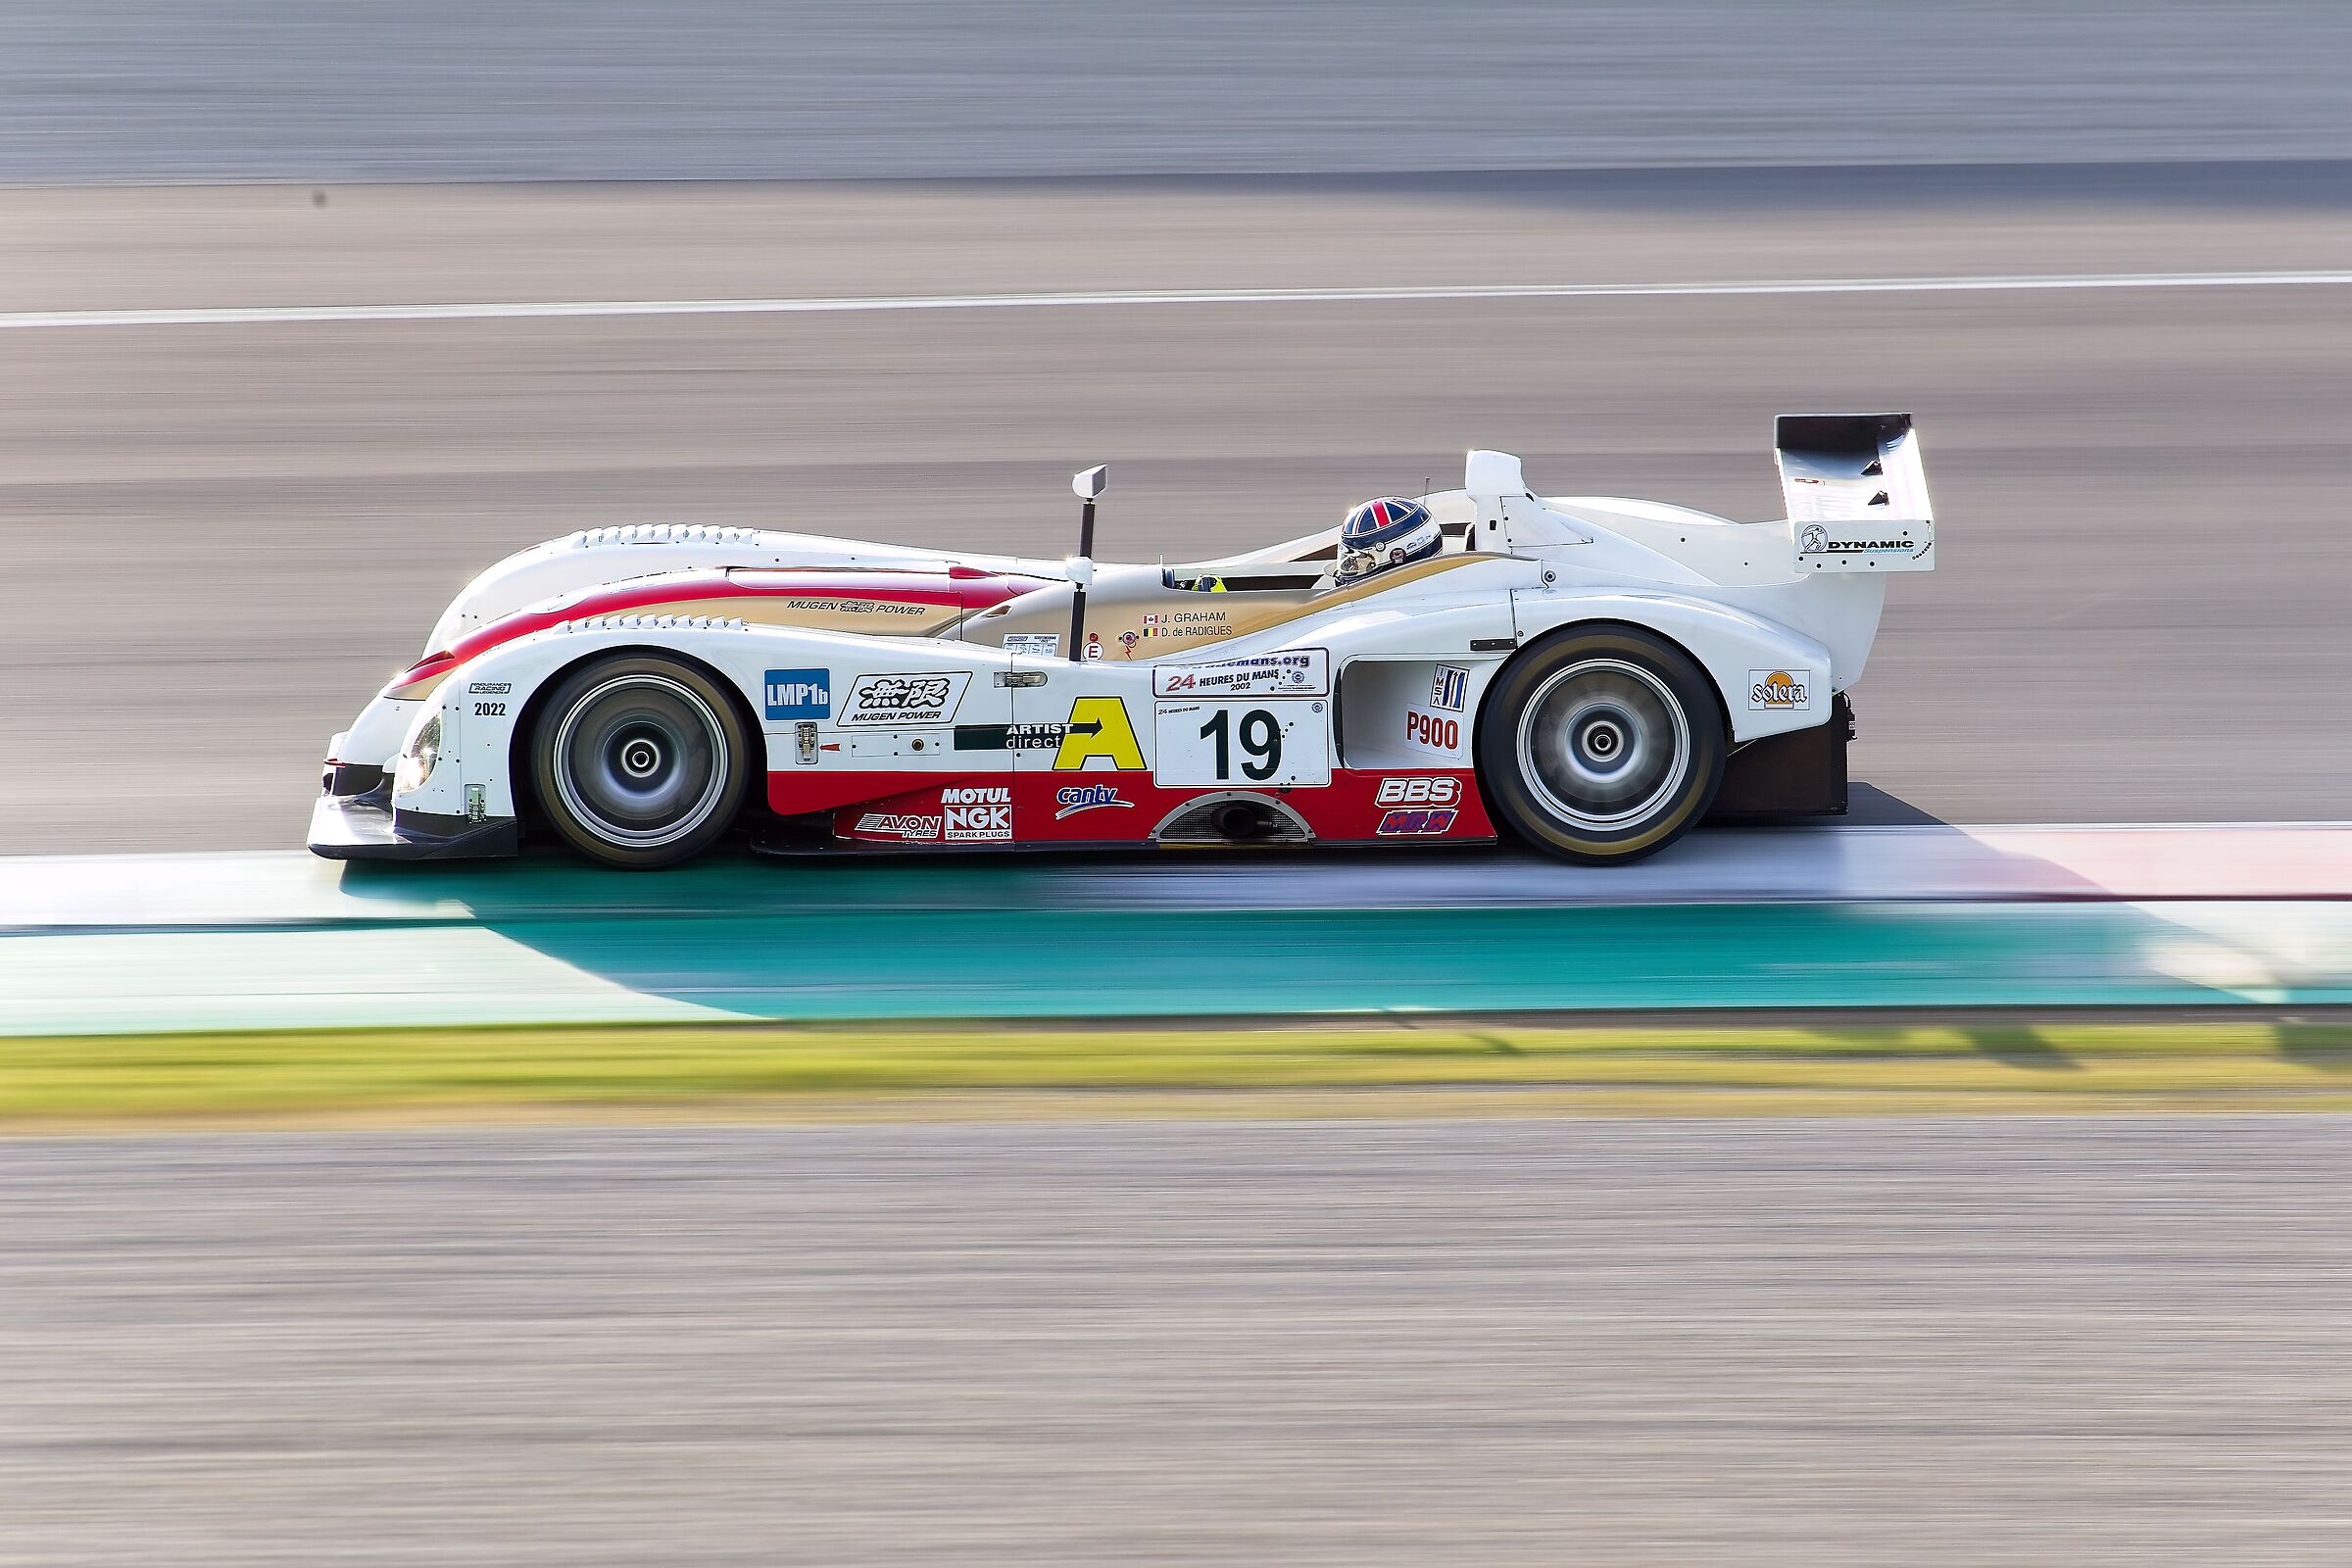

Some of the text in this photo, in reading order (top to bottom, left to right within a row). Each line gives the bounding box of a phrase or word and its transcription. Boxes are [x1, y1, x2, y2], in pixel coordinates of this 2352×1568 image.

[1828, 540, 1915, 549] DYNAMIC
[787, 601, 839, 611] MUGEN
[875, 605, 926, 615] POWER
[1161, 612, 1226, 623] J. GRAHAM
[1161, 625, 1233, 637] D. de RADIGUES
[1088, 645, 1099, 658] E
[1165, 673, 1196, 692] 24
[1199, 674, 1235, 687] HEURES
[1236, 672, 1250, 682] DU
[1251, 668, 1279, 680] MANS
[1230, 681, 1251, 692] 2002
[1432, 667, 1445, 706] IMSA
[766, 683, 829, 707] LMP1b
[1751, 681, 1808, 703] solera
[474, 702, 506, 716] 2022
[851, 710, 942, 721] MUGEN POWER
[1005, 723, 1074, 735] ARTIST
[1406, 710, 1459, 751] P900
[1005, 735, 1061, 749] direct
[1200, 709, 1282, 781] 19
[941, 787, 1012, 804] MOTUL
[1056, 784, 1118, 805] canty
[1377, 779, 1457, 804] BBS
[877, 815, 941, 830] AVON
[946, 807, 1010, 830] NGK
[904, 829, 938, 838] TYRES
